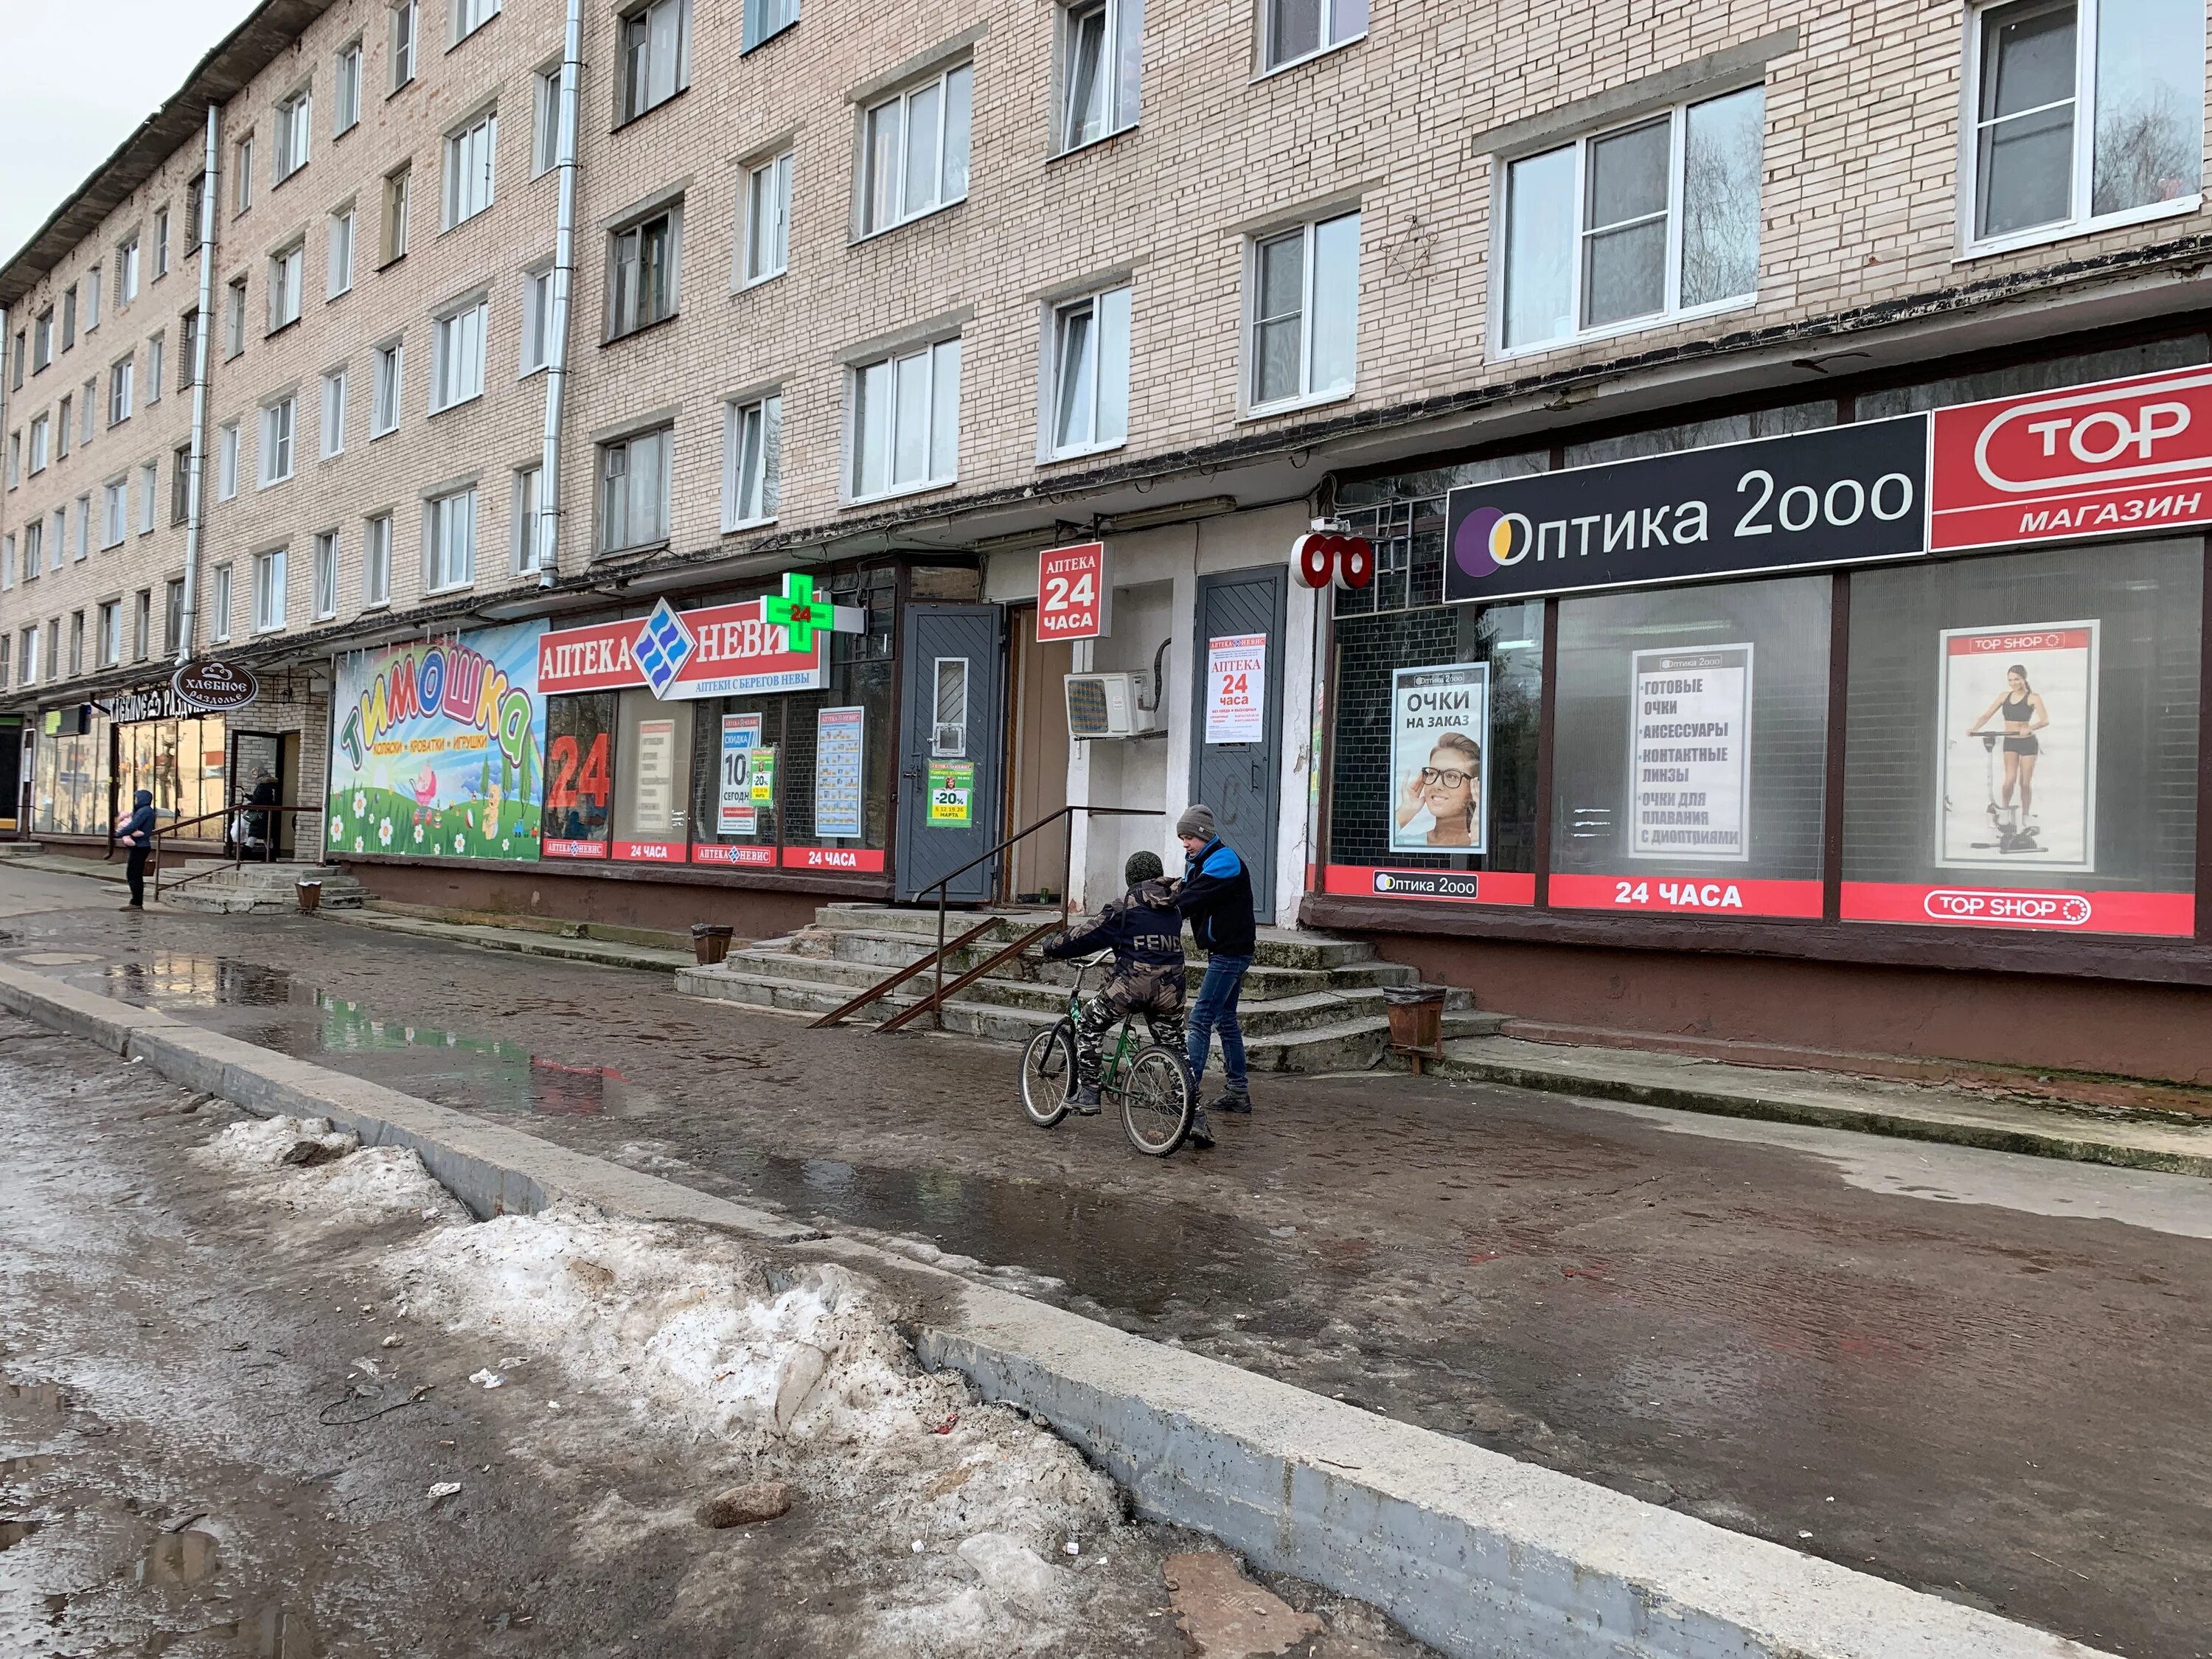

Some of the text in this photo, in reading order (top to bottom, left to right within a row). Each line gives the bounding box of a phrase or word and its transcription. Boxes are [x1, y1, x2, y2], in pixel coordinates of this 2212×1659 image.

[2028, 401, 2191, 463] TOP
[2018, 493, 2202, 533] МАГАЗИН
[1488, 500, 1708, 566] Оптика
[1046, 555, 1096, 574] АПТЕКА
[1044, 573, 1095, 611] 24
[790, 604, 811, 622] 24
[1043, 612, 1093, 630] ЧАСА
[539, 619, 787, 680] АПТЕКА НЕВИ
[1975, 636, 2042, 650] TOP SHOP
[1211, 659, 1261, 672] АПТЕКА
[186, 678, 247, 692] ХЛЕБНОЕ
[695, 672, 810, 693] АПТЕКИ С БЕРЕГОВ НЕВЫ
[1222, 673, 1248, 695] 24
[1644, 678, 1703, 695] ГОТОВЫЕ
[1220, 696, 1248, 706] часа
[1407, 691, 1470, 712] ОЧКИ
[1644, 700, 1677, 715] ОЧКИ
[1406, 715, 1470, 728] НА ЗАКАЗ
[1644, 722, 1728, 739] АКСЕССУАРЫ
[453, 734, 488, 751] ИГРУШКИ
[725, 734, 748, 745] СКИДКА
[1643, 747, 1728, 762] КОНТАКТНЫЕ
[547, 732, 611, 808] 24
[1642, 768, 1689, 782] ЛИНЗЫ
[723, 792, 749, 803] СЕГОДН
[936, 793, 964, 804] -20%
[1642, 792, 1706, 808] ОЧКИ ДЛЯ
[1642, 811, 1709, 825] ПЛАВАНИЯ
[1641, 830, 1739, 845] С ДИОПТРИЯМИ
[548, 842, 602, 855] АПТЕКА НЕВИС
[631, 845, 667, 858] 24 ЧАСА
[699, 849, 769, 861] АПТЕКА НЕВИС
[808, 851, 856, 866] 24 ЧАСА
[1385, 875, 1434, 892] Оптика
[1615, 882, 1742, 908] 24 ЧАСА
[1939, 896, 2056, 917] TOP SHOP
[1133, 934, 1182, 952] FEND
